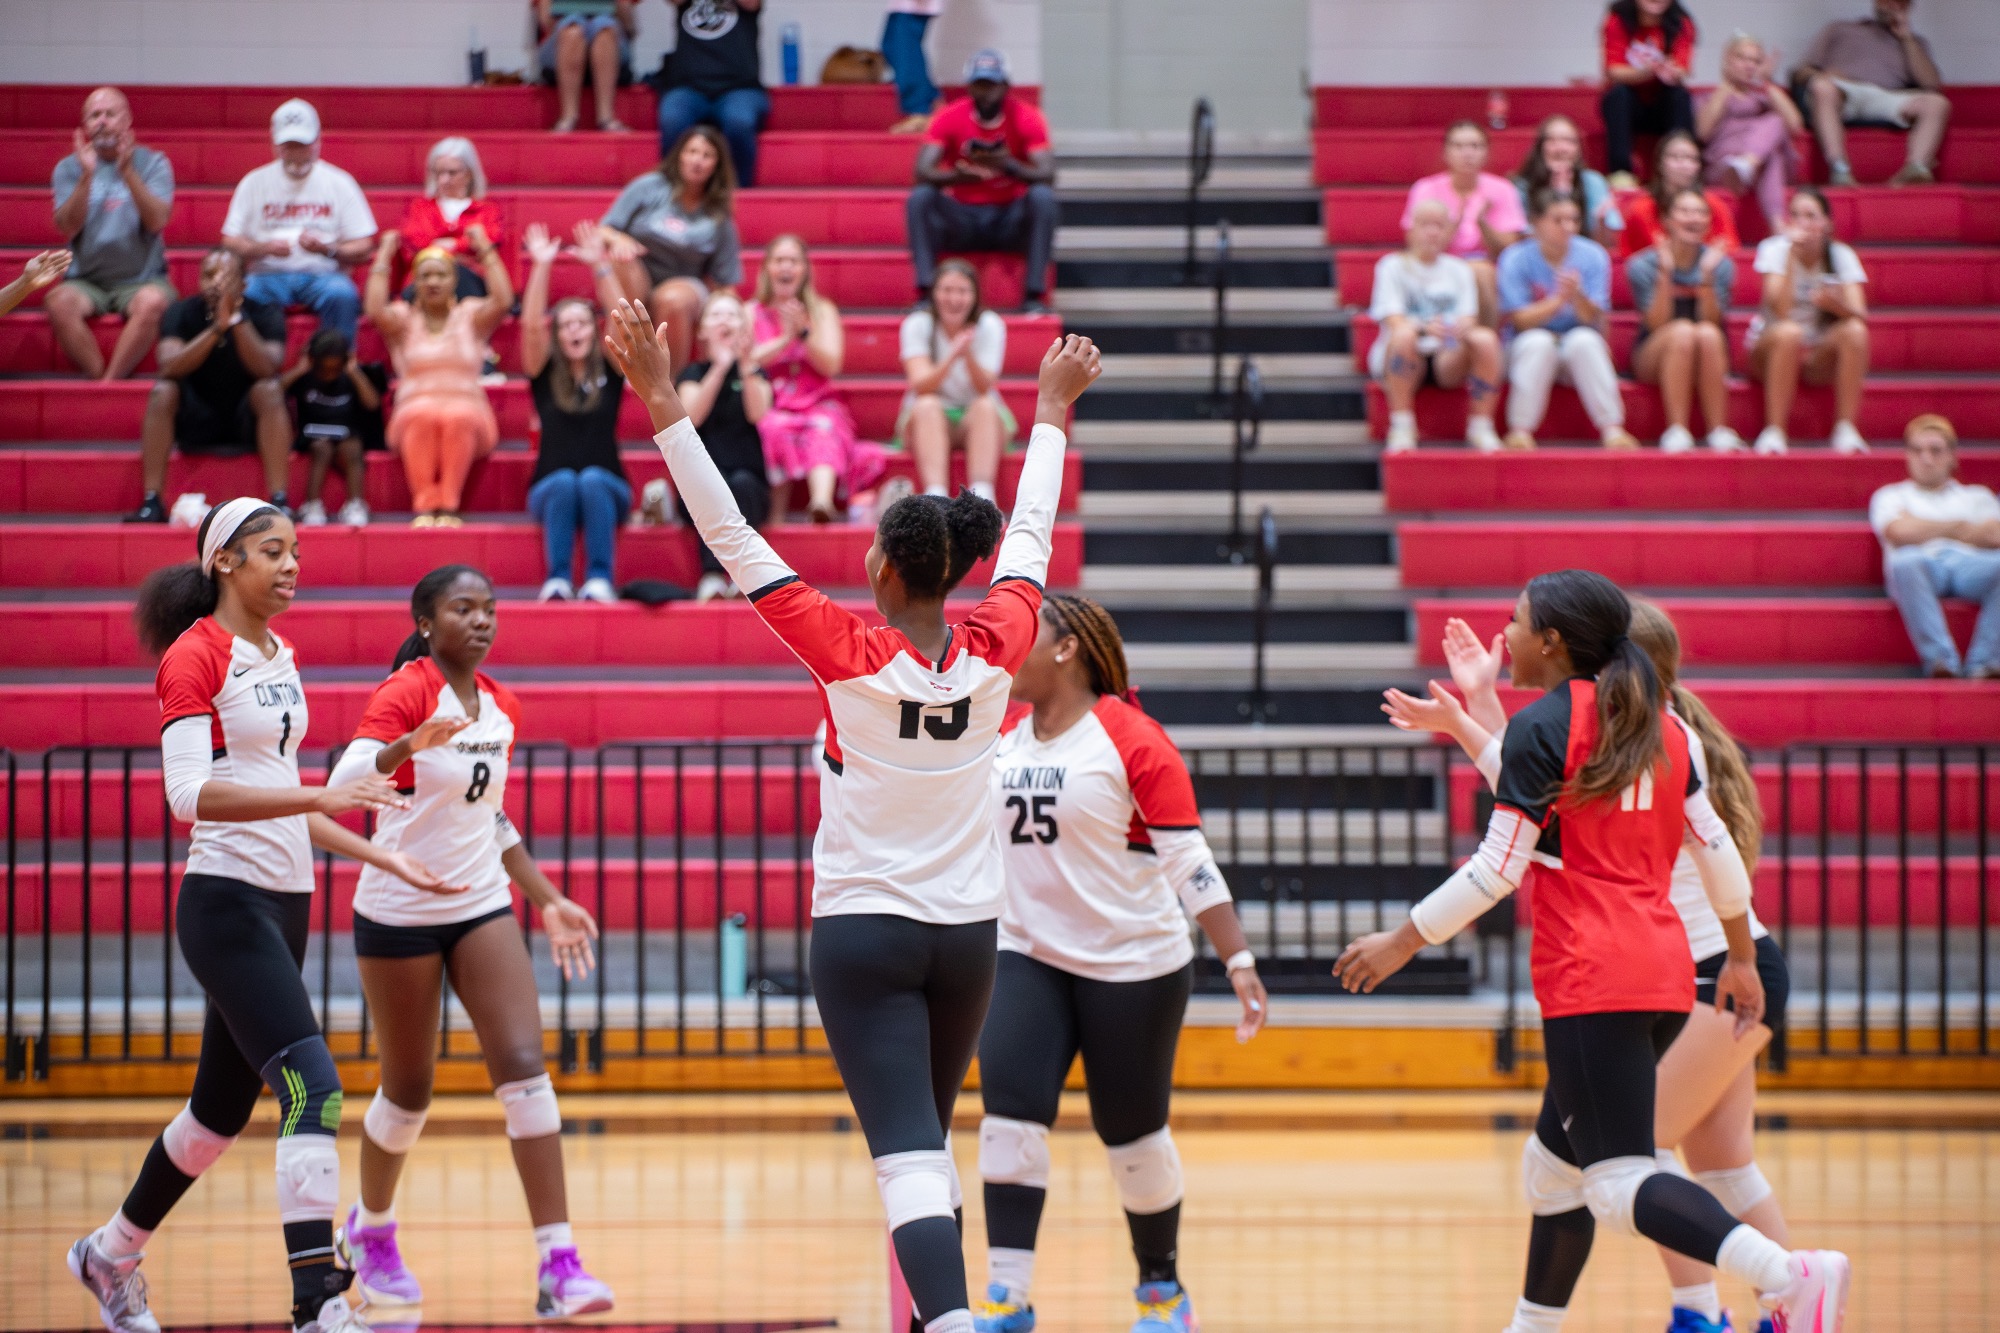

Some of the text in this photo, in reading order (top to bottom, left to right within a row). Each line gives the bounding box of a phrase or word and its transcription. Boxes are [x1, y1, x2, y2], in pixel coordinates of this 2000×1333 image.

[279, 711, 291, 757] 1
[465, 762, 490, 803] 8
[1002, 766, 1067, 790] CLINTON
[1005, 795, 1058, 845] 25
